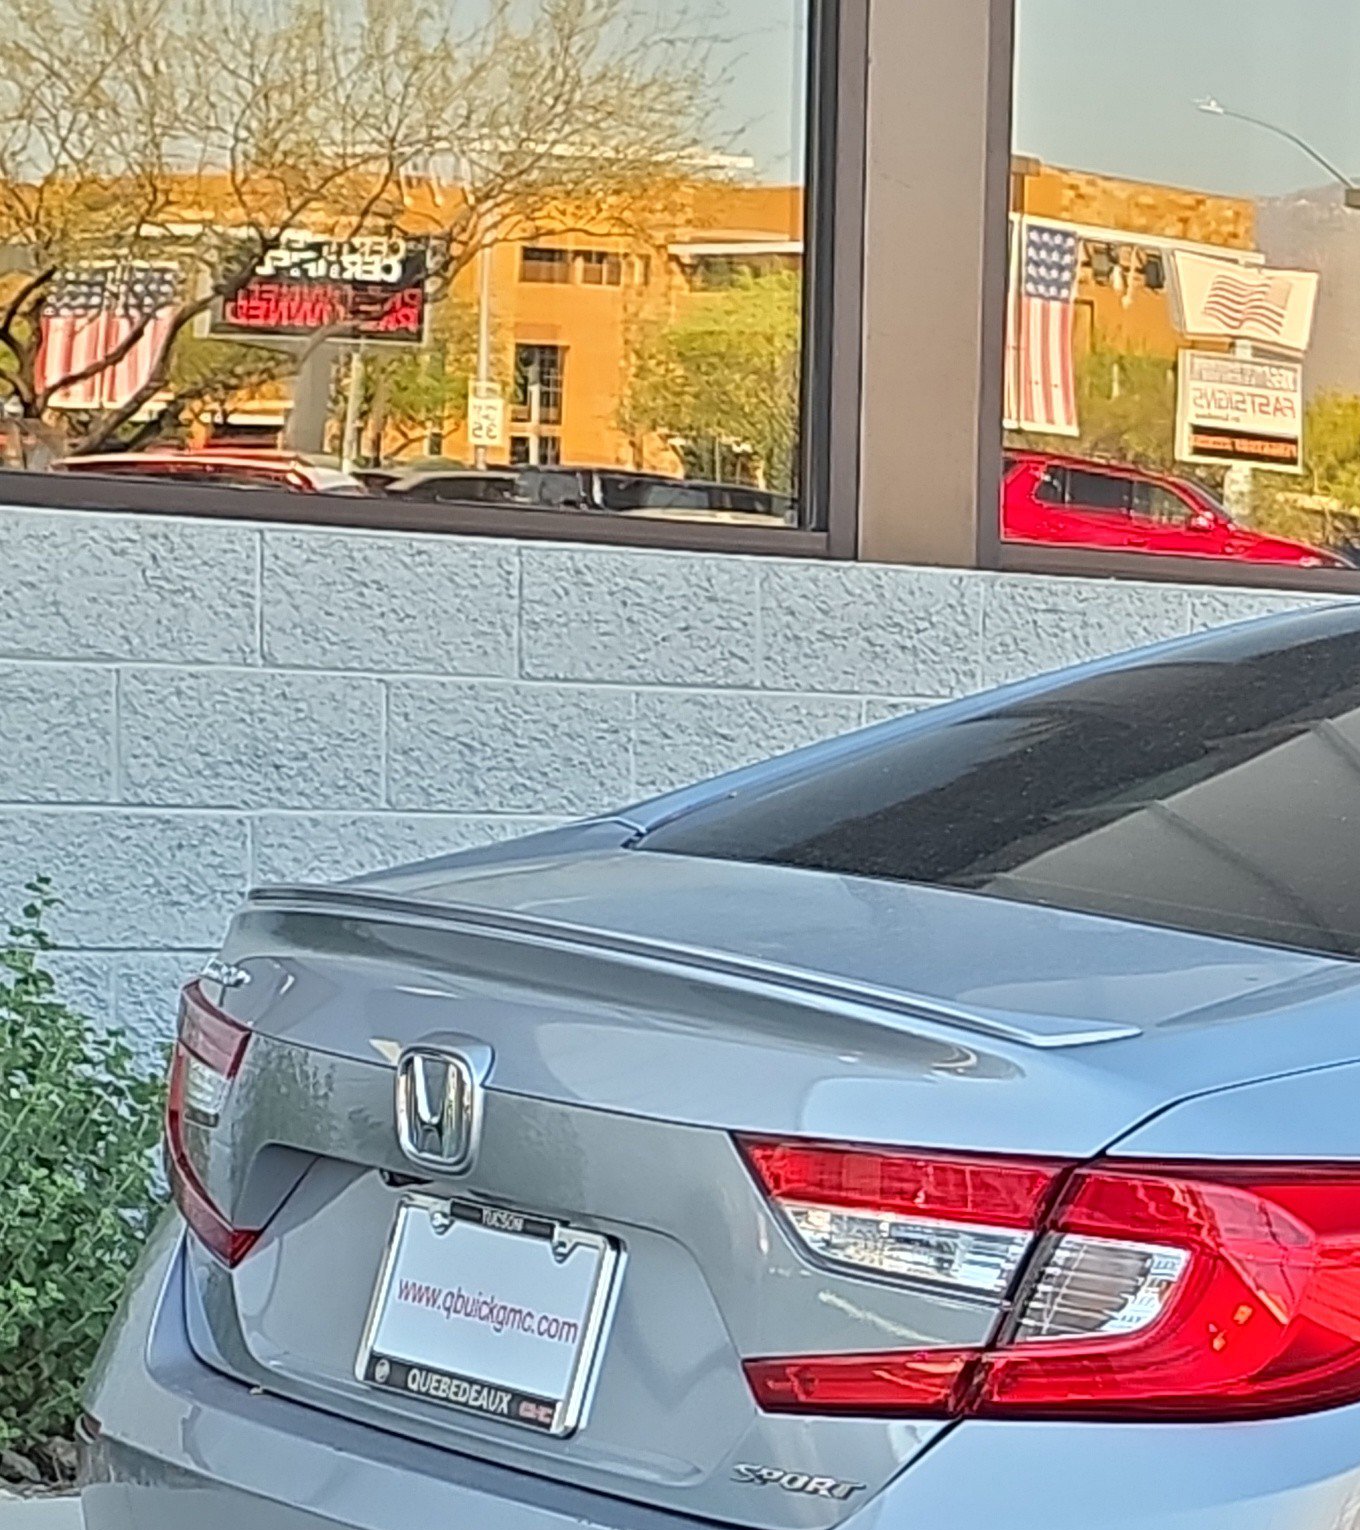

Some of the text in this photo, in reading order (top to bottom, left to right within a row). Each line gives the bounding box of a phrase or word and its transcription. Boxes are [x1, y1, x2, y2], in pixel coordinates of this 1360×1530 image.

[481, 1206, 524, 1232] TUCSON
[397, 1277, 580, 1345] www.qbuickgmc.com
[406, 1367, 513, 1415] QUEBEDEAUX
[730, 1461, 867, 1500] SPORT
